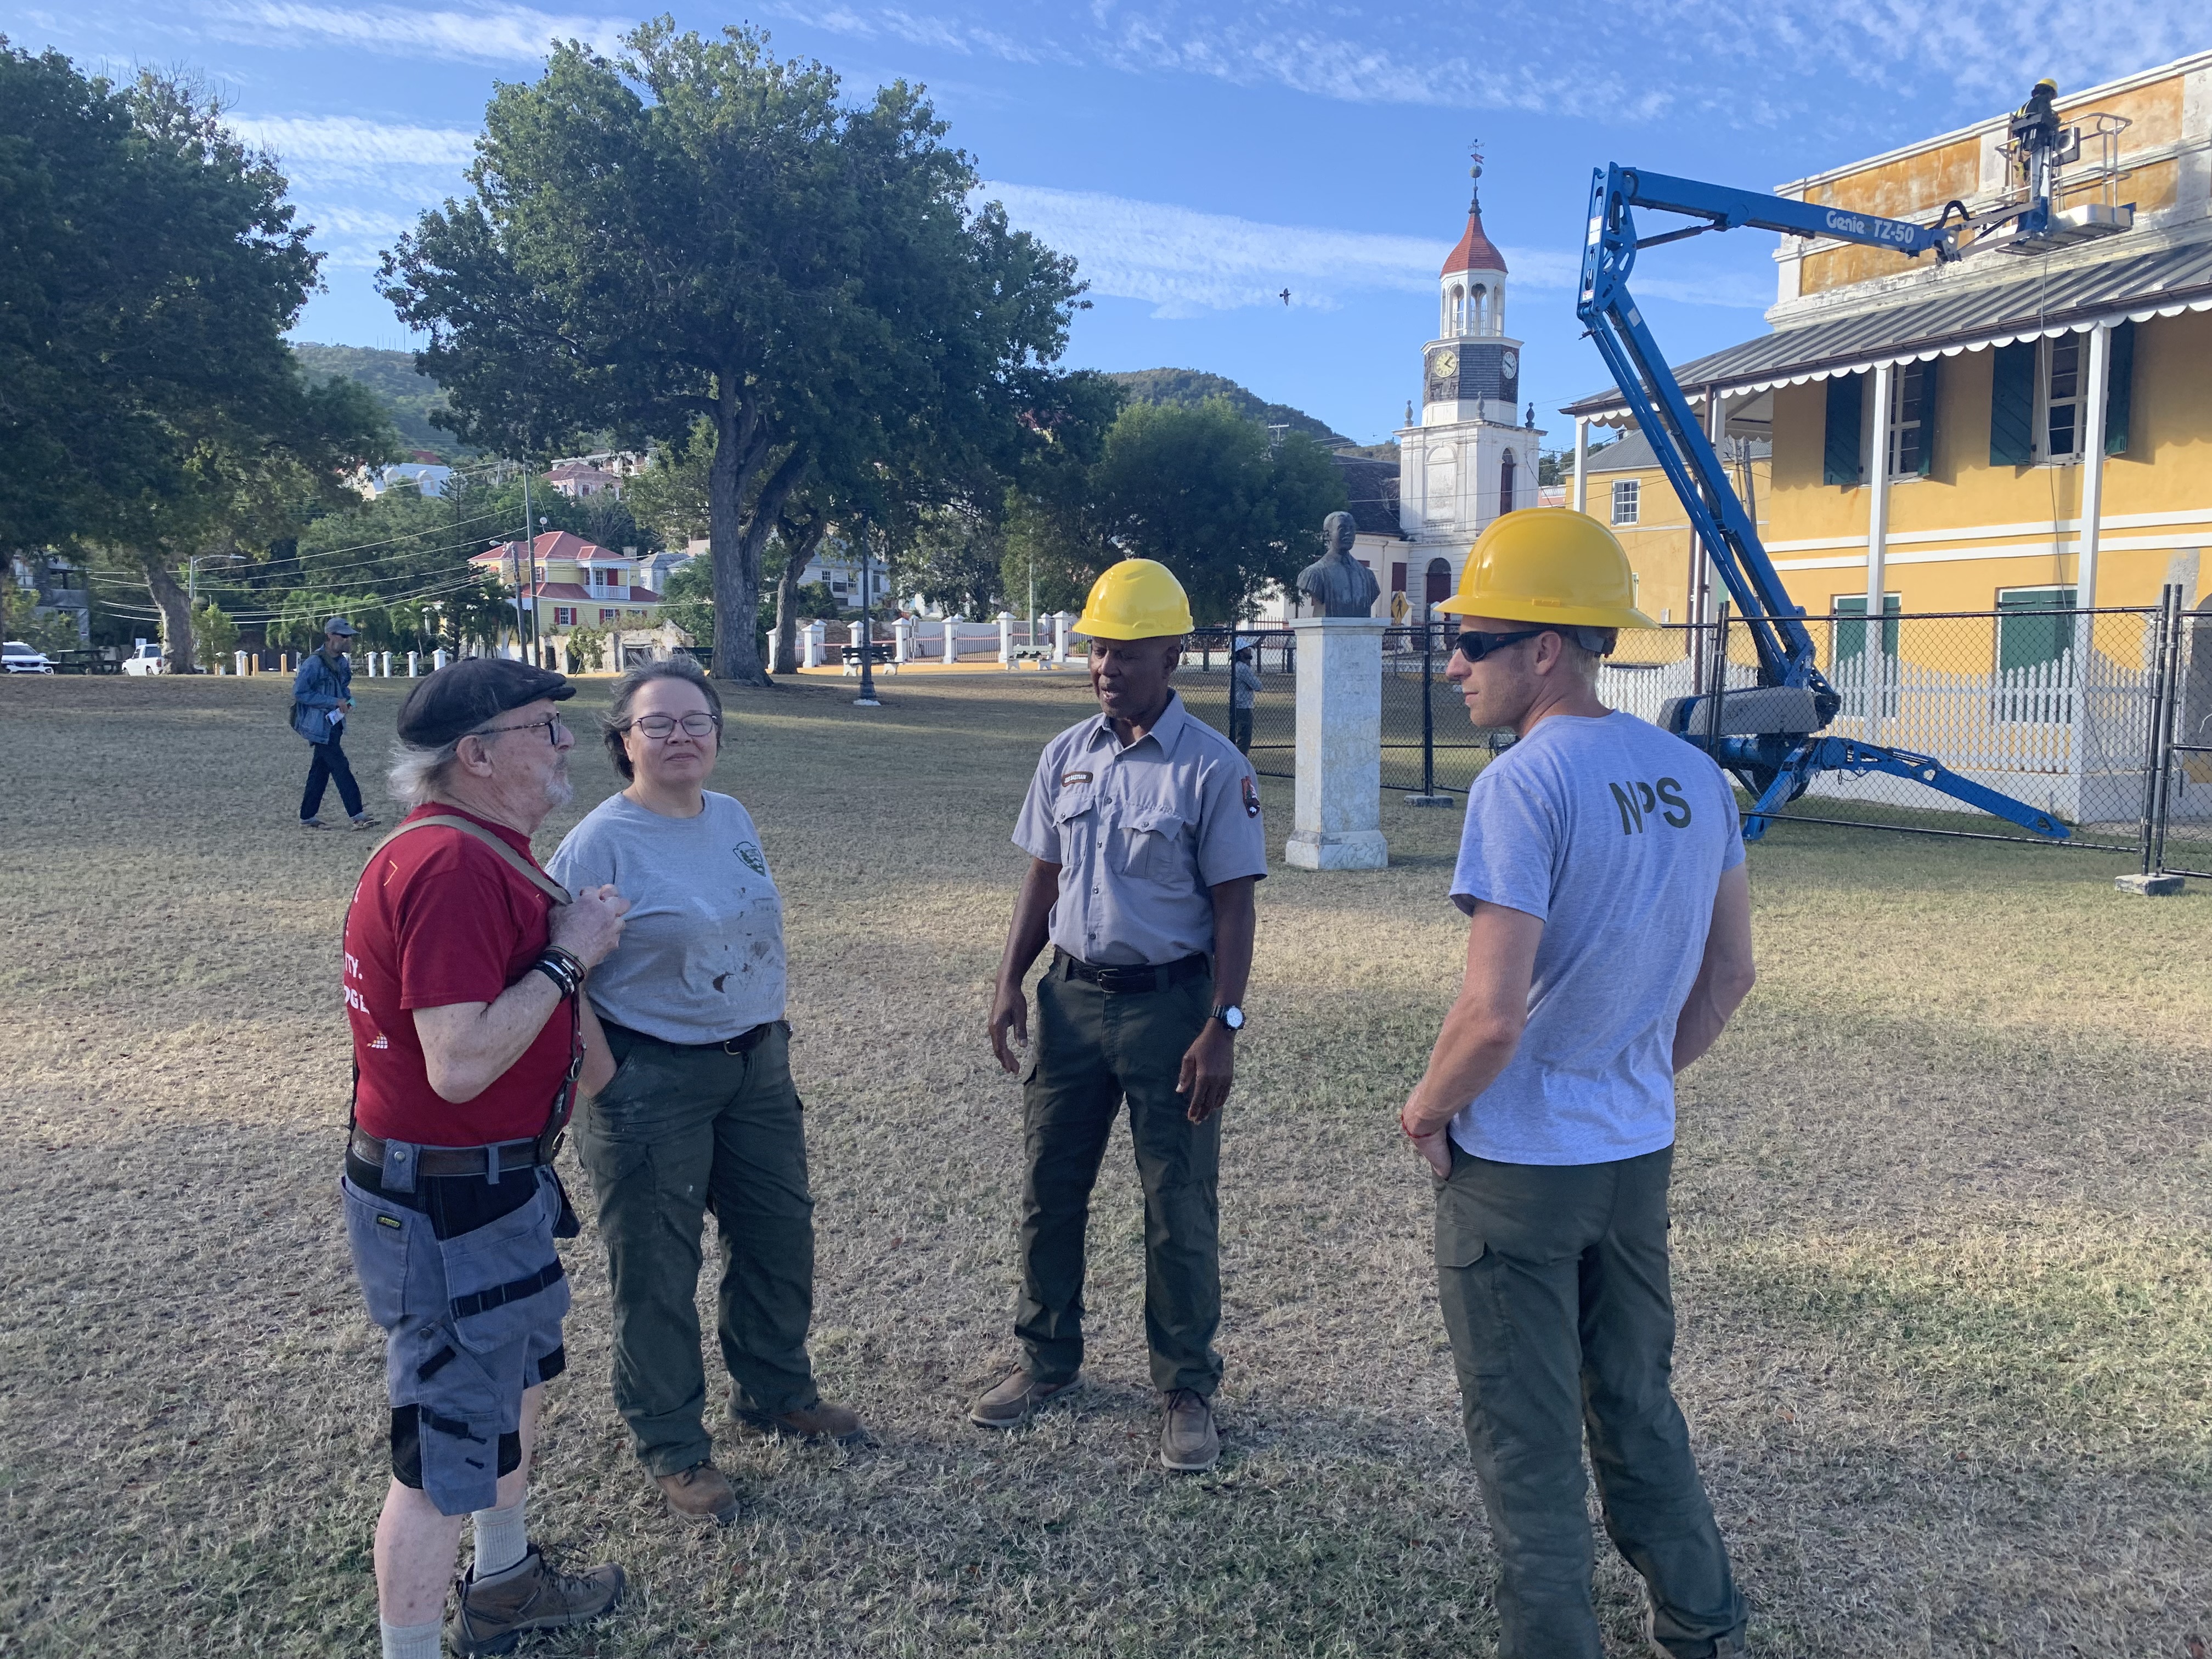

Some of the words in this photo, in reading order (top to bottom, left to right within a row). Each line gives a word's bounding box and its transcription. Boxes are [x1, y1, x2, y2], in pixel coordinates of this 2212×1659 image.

[1826, 210, 1865, 235] Genie
[1874, 219, 1915, 244] TZ-50
[1609, 777, 1692, 836] NPS
